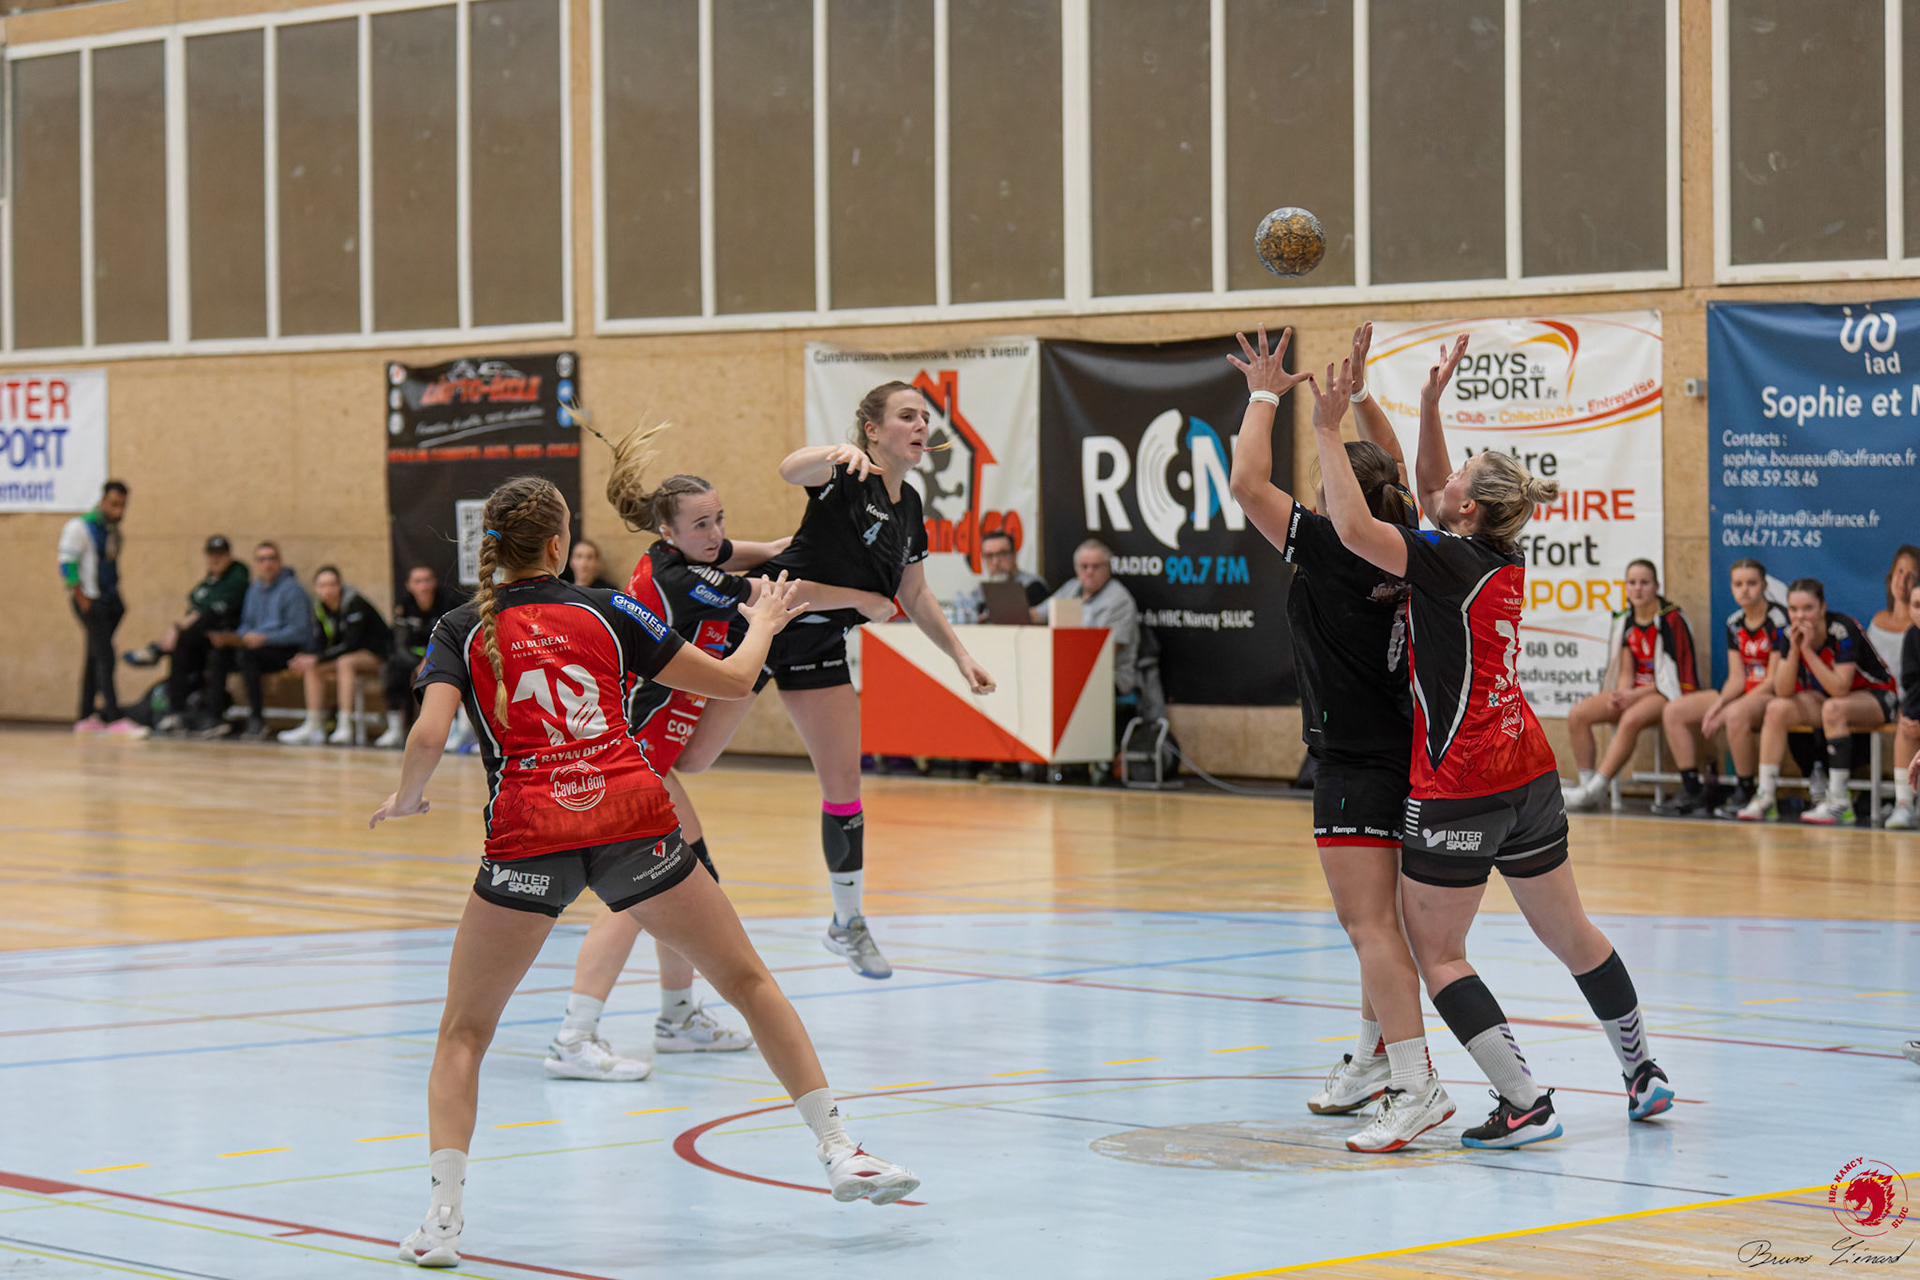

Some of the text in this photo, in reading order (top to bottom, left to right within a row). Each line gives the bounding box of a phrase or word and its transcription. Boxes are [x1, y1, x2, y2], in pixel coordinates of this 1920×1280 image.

[989, 343, 1029, 357] avenir
[1457, 353, 1527, 377] PAYS
[1864, 351, 1901, 374] iad
[0, 380, 70, 420] TER
[1456, 410, 1487, 424] Club
[1500, 406, 1574, 424] Collectivité
[1587, 378, 1656, 413] Entreprise
[1762, 384, 1863, 427] Sophie
[1871, 388, 1903, 417] et
[863, 521, 883, 545] 4
[1289, 512, 1301, 539] Kempa
[1284, 545, 1296, 563] Kemp
[1110, 555, 1250, 585] RADIO 90.7 FM
[1183, 609, 1220, 631] Nancy
[1220, 610, 1254, 628] SLUC
[510, 635, 569, 651] AU BUREAU
[511, 664, 609, 747] 18
[541, 749, 580, 763] RAYAN
[554, 777, 578, 798] Cave
[581, 773, 606, 793] Léon
[1332, 825, 1357, 835] Kempa
[1364, 826, 1389, 837] Kempa
[1446, 830, 1482, 842] INTER
[1446, 840, 1481, 851] SPORT
[508, 882, 549, 896] SPORT
[510, 870, 550, 886] INTER
